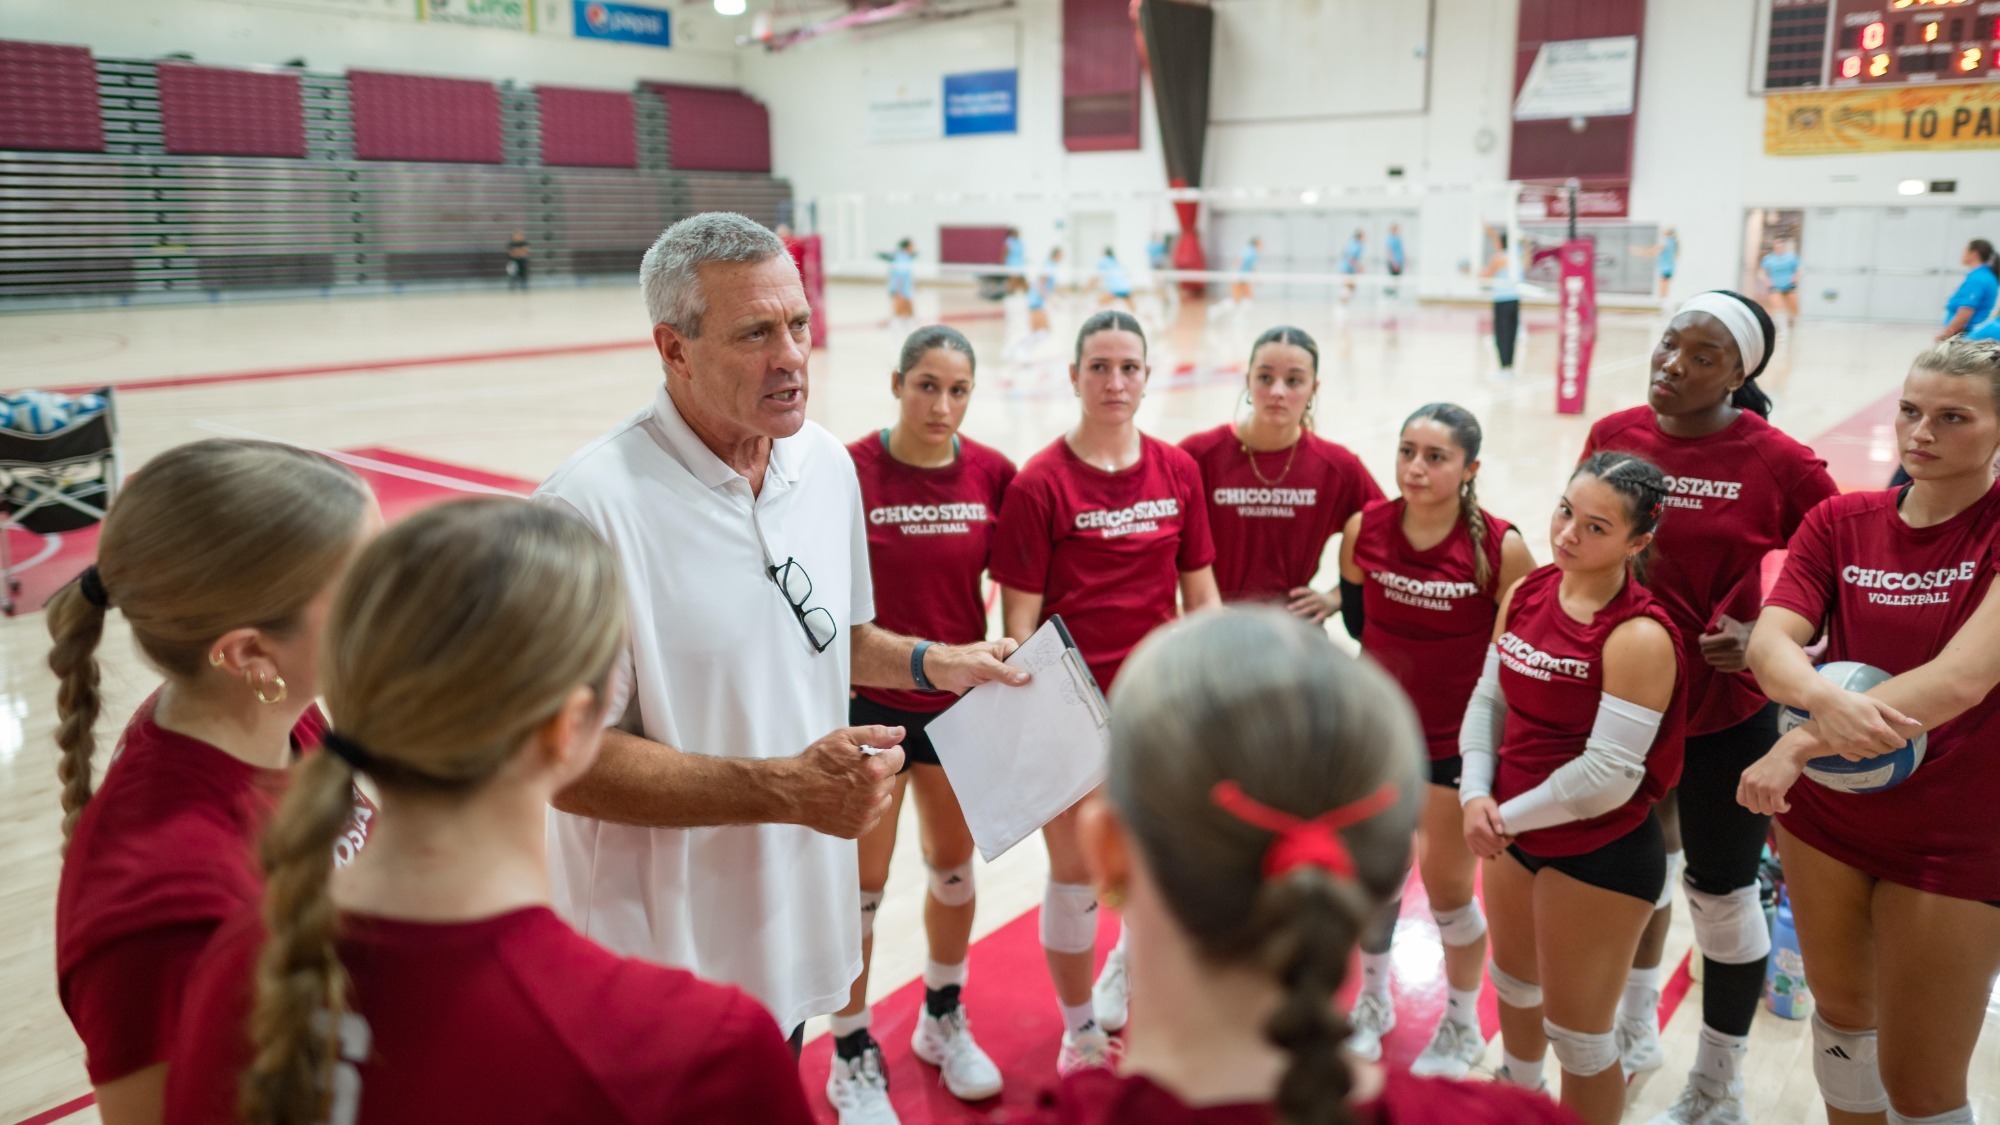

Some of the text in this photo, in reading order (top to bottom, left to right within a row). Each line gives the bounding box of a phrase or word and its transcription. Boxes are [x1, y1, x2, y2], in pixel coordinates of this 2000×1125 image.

[1862, 22, 1885, 50] 0
[1869, 53, 1890, 77] 2
[1960, 47, 1982, 71] 2
[1902, 109, 1938, 139] TO
[1951, 107, 2000, 138] PA
[1075, 498, 1179, 528] CHCOSTATE
[1237, 506, 1295, 517] VOLLEYBALL
[900, 523, 969, 534] VOLLEYBALL
[1842, 562, 1976, 590] CHICOSTAE
[1384, 589, 1452, 611] VOLLEYBALL
[1868, 592, 1950, 605] VOLLEYBALL
